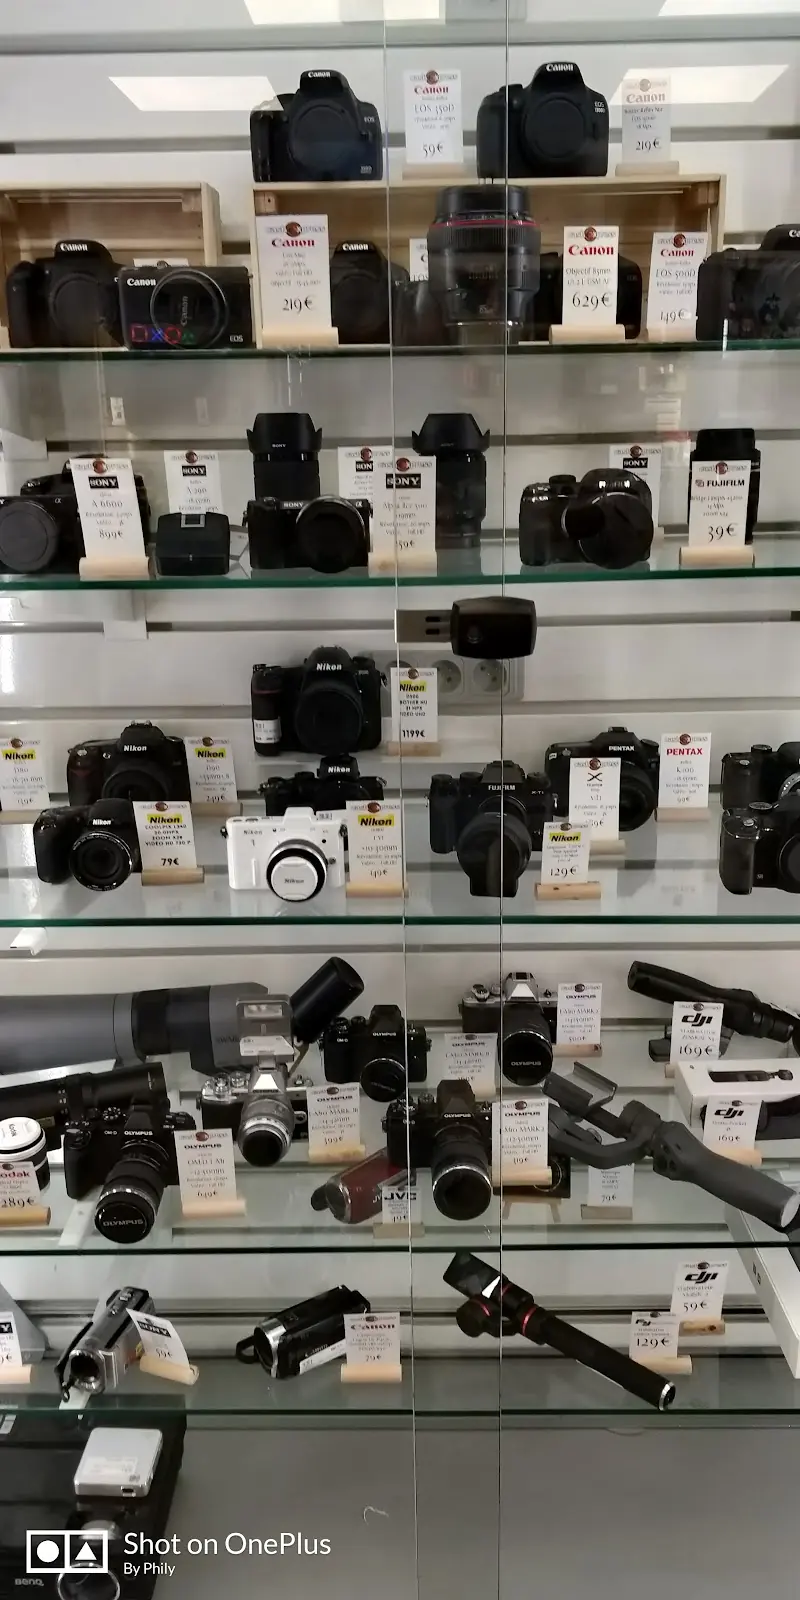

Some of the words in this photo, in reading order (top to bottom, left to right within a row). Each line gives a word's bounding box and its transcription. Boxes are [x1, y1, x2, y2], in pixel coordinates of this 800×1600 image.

[546, 64, 574, 72] Canon
[414, 85, 449, 95] Canon
[626, 93, 666, 103] Canon
[60, 243, 88, 251] Canon
[271, 238, 315, 248] Canon
[342, 243, 369, 251] Canon
[568, 244, 614, 256] Canon
[660, 248, 694, 257] Canon
[127, 278, 157, 287] Canon
[283, 294, 317, 314] 219€
[572, 291, 613, 311] 629€
[180, 296, 188, 325] Canon
[230, 335, 244, 343] EOS
[356, 462, 373, 470] SON
[624, 459, 647, 468] SONY
[183, 467, 206, 475] SONY
[89, 478, 117, 487] SONY
[387, 477, 420, 486] SONY
[706, 479, 745, 487] FUJIFILM
[708, 523, 739, 543] 39€
[316, 663, 342, 671] Nikon
[399, 683, 425, 692] Nikon
[402, 729, 426, 738] 1199€
[124, 744, 147, 752] Nikon
[666, 747, 703, 756] PENTAX
[5, 752, 34, 760] Nikon
[197, 750, 225, 758] Nikon
[149, 816, 181, 824] Nikon
[360, 817, 393, 827] Nikon
[550, 834, 579, 842] Nikon
[161, 857, 180, 867] 79€
[550, 865, 579, 878] 129€
[679, 1043, 717, 1059] 169€
[0, 1170, 30, 1179] odak
[384, 1192, 417, 1201] JVC
[1, 1196, 35, 1209] 289€
[102, 1219, 144, 1227] OLYMPUS
[683, 1300, 708, 1312] 59€
[636, 1337, 671, 1349] 129€
